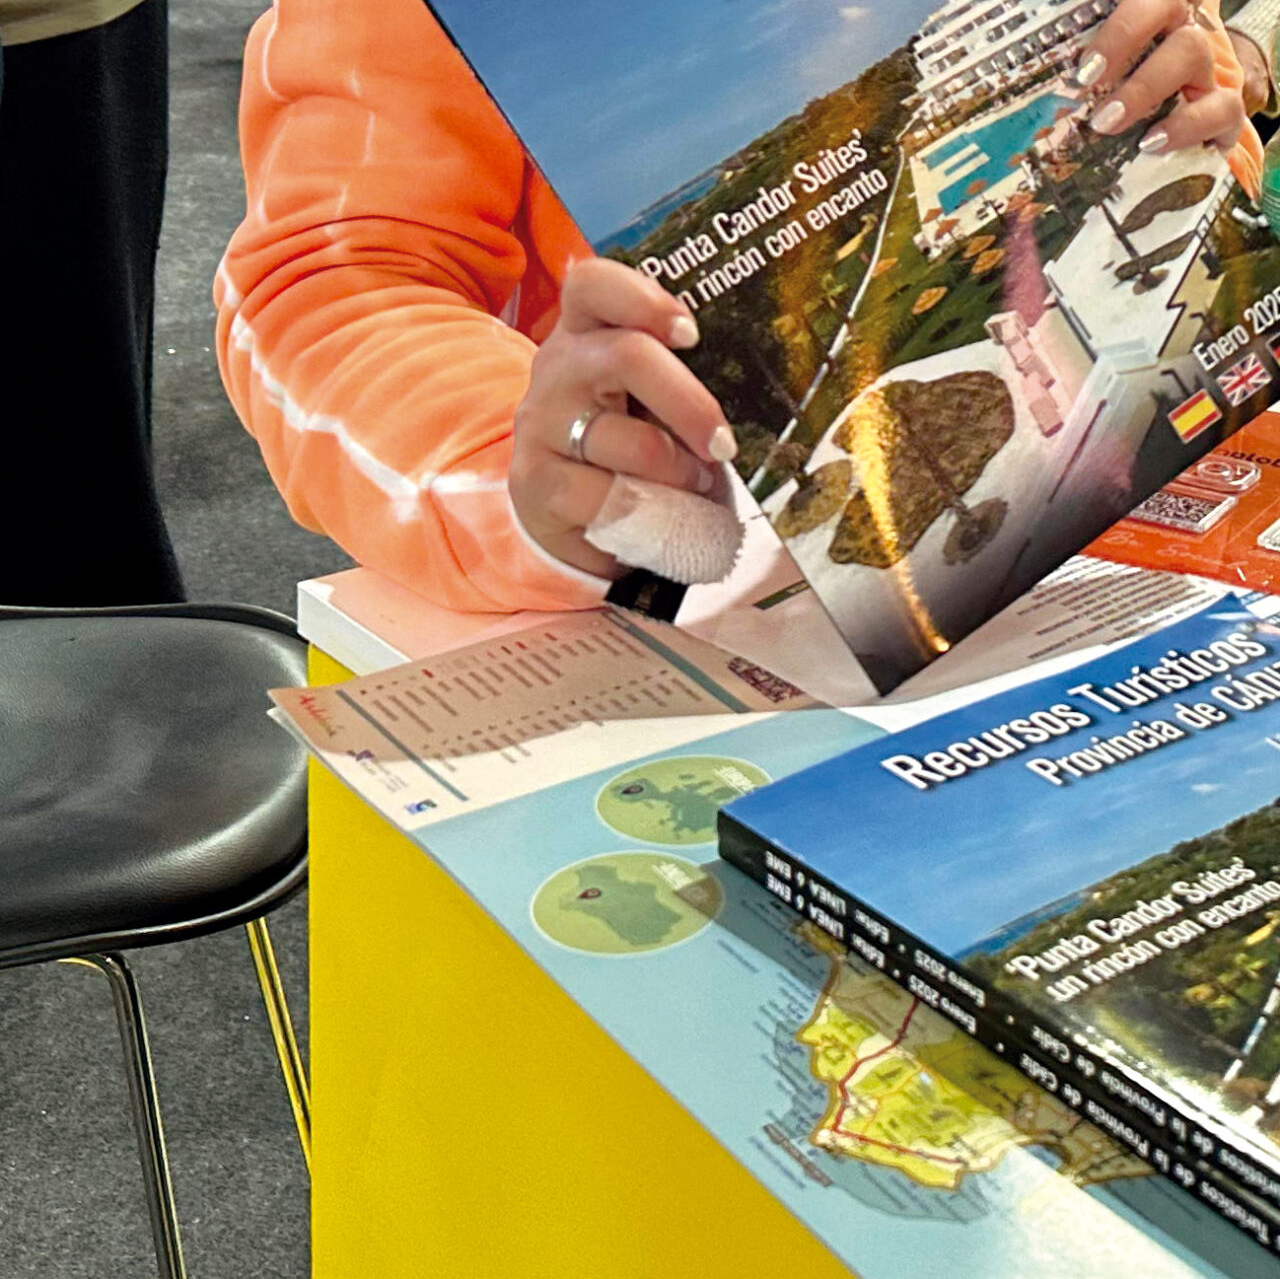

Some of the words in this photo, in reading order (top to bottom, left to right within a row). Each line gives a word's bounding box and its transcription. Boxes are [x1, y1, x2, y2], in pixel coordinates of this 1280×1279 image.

[712, 179, 798, 246] Candor
[676, 288, 700, 312] n
[696, 244, 767, 303] rincón
[763, 219, 808, 258] con
[806, 168, 889, 232] encanto
[1192, 323, 1250, 371] Enero
[881, 702, 1092, 790] Recursos
[1067, 628, 1269, 714] Turísticos
[1026, 718, 1186, 786] Provincia
[1175, 698, 1228, 730] de
[764, 850, 792, 880] EME
[796, 871, 806, 888] 6
[766, 872, 792, 903] EME
[795, 894, 805, 911] 6
[808, 879, 847, 916] LÍNEA
[807, 902, 845, 941] LÍNEA
[1087, 894, 1183, 944] Candor
[914, 949, 947, 983] 2025
[1046, 974, 1091, 1003] un
[1081, 938, 1163, 985] rincón
[1155, 919, 1207, 950] con
[908, 974, 938, 1007] 2025
[946, 971, 986, 1008] Enero
[939, 996, 978, 1035] Enero
[1031, 1026, 1071, 1064] Cádiz
[1019, 1051, 1059, 1093] Cádiz
[1074, 1054, 1096, 1078] de
[1061, 1082, 1083, 1108] de
[1100, 1070, 1167, 1127] Provincia
[1086, 1100, 1150, 1159] Provincia
[1171, 1116, 1188, 1141] la
[1192, 1128, 1214, 1155] de
[1153, 1147, 1171, 1174] la
[1172, 1162, 1196, 1187] de
[1201, 1179, 1271, 1245] Turísticos
